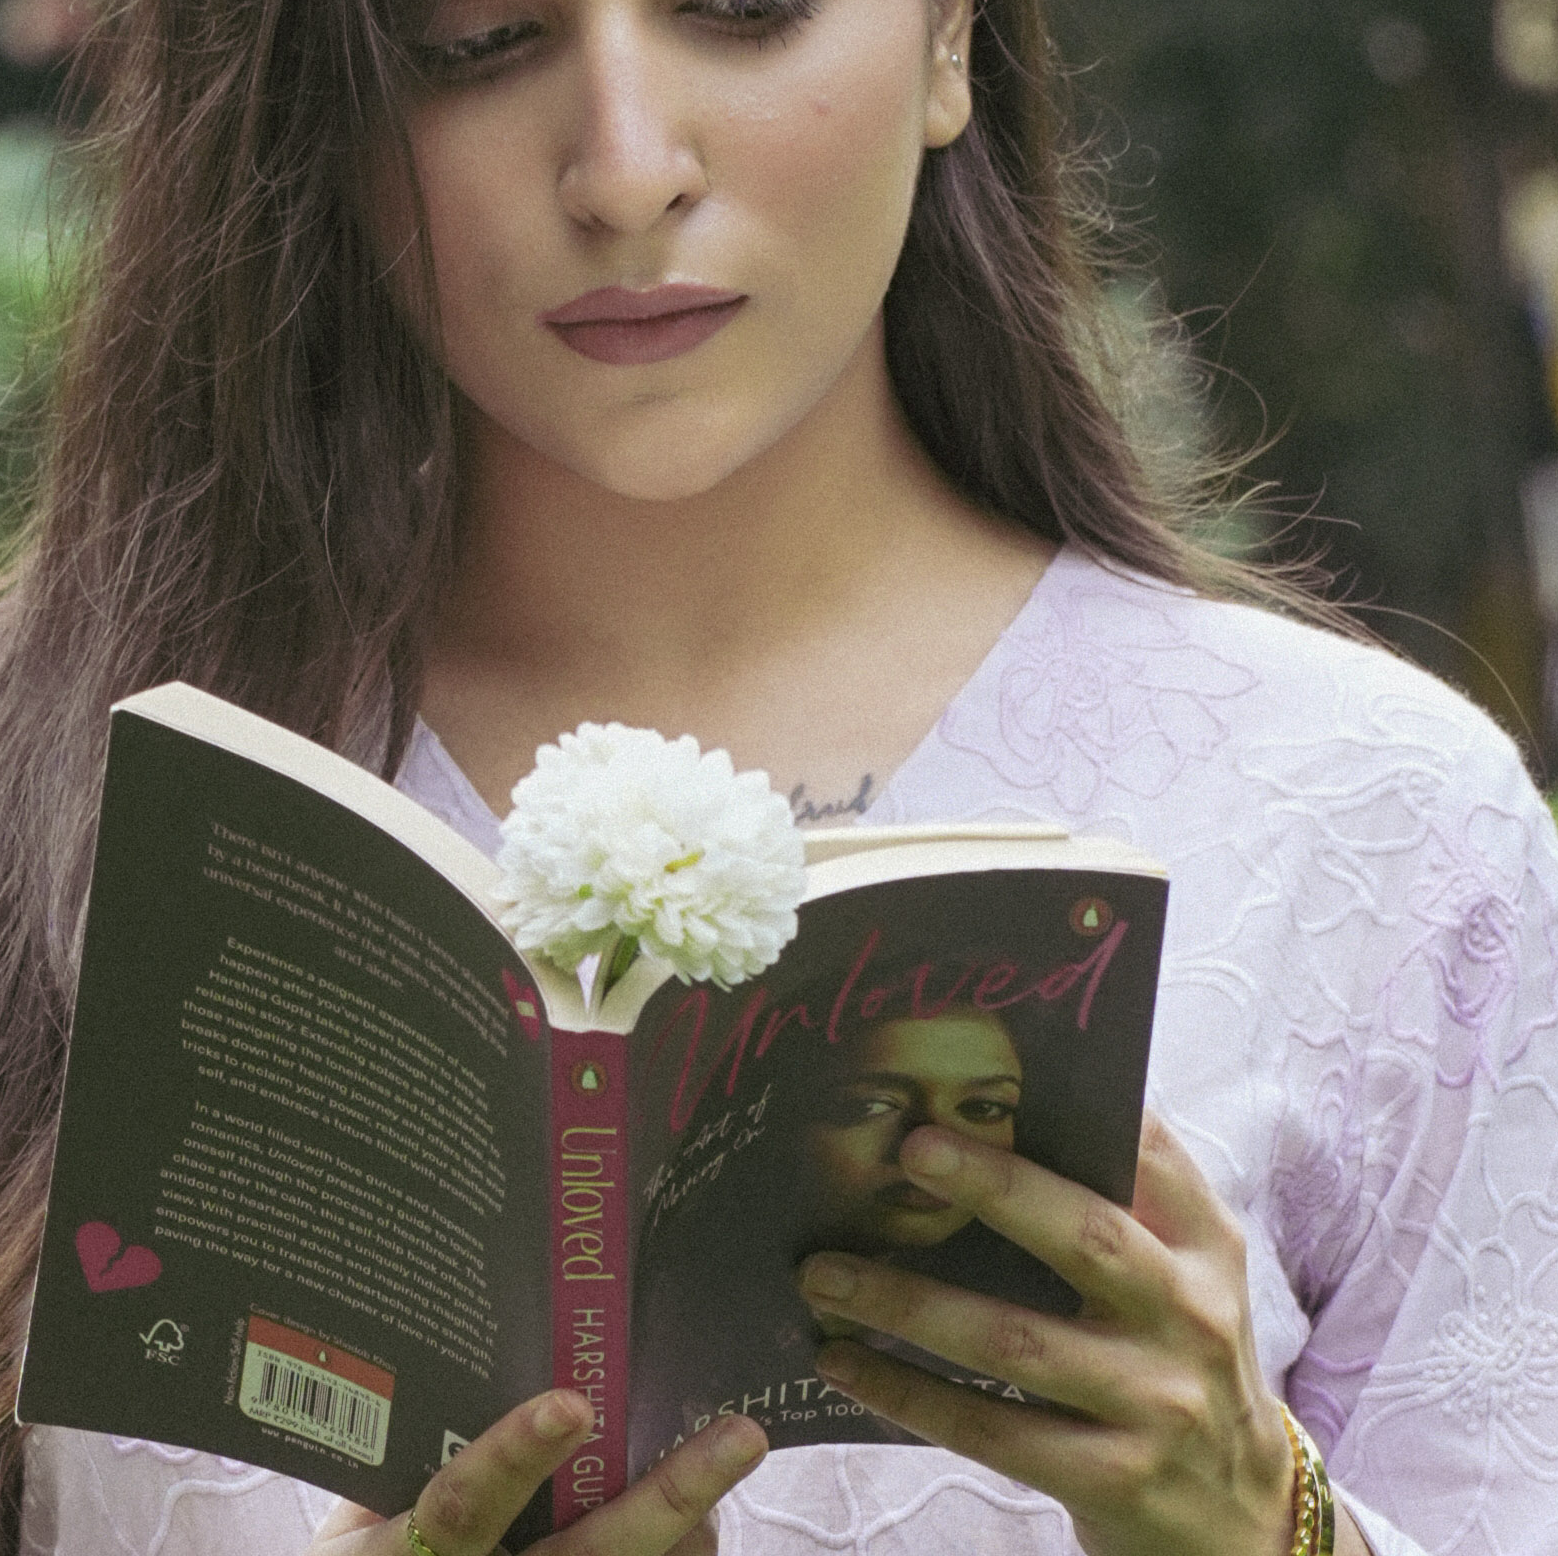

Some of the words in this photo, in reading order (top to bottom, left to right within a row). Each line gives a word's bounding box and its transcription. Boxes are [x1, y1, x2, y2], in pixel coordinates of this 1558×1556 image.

[208, 969, 268, 1001] Harshita
[270, 993, 312, 1020] Gupta
[315, 1013, 350, 1038] takes
[353, 1033, 377, 1052] you
[219, 953, 279, 986] happens
[282, 980, 314, 1000] after
[317, 996, 360, 1024] you've
[362, 1017, 395, 1043] been
[226, 935, 304, 977] Experience
[306, 972, 316, 983] a
[317, 977, 376, 1013] poignant
[180, 1018, 228, 1044] breaks
[230, 1037, 269, 1059] down
[272, 1052, 296, 1070] her
[298, 1063, 348, 1096] healing
[350, 1089, 400, 1122] journey
[183, 999, 223, 1022] those
[226, 1016, 298, 1054] navigating
[300, 1045, 323, 1063] the
[325, 1056, 392, 1098] loneliness
[195, 985, 257, 1016] relatable
[299, 1024, 366, 1067] Extending
[369, 1061, 410, 1091] solace
[182, 1038, 221, 1061] tricks
[224, 1053, 239, 1067] to
[241, 1061, 293, 1088] reclaim
[295, 1083, 326, 1102] your
[375, 1121, 420, 1152] rebuild
[229, 1077, 257, 1094] and
[259, 1087, 320, 1119] embrace
[321, 1114, 331, 1125] a
[333, 1117, 373, 1145] future
[375, 1138, 408, 1164] filled
[182, 1137, 236, 1162] oneself
[238, 1155, 293, 1184] through
[295, 1177, 318, 1195] the
[320, 1190, 374, 1221] process
[376, 1216, 391, 1229] of
[194, 1100, 209, 1115] In
[211, 1108, 221, 1119] a
[223, 1113, 264, 1134] world
[267, 1126, 301, 1150] filled
[303, 1144, 333, 1163] with
[335, 1156, 363, 1178] love
[365, 1173, 403, 1199] gurus
[267, 1147, 325, 1178] Unloved
[325, 1173, 383, 1207] presents
[385, 1202, 394, 1213] a
[159, 1168, 219, 1195] antidote
[221, 1187, 236, 1201] to
[238, 1193, 309, 1229] heartache
[311, 1224, 341, 1243] with
[343, 1238, 352, 1248] a
[354, 1243, 411, 1278] uniquely
[172, 1153, 215, 1175] chaos
[218, 1169, 251, 1186] after
[255, 1180, 278, 1197] the
[320, 1207, 345, 1226] this
[348, 1221, 404, 1256] self-help
[561, 1126, 618, 1282] Unloved
[154, 1225, 202, 1249] paving
[205, 1240, 229, 1256] the
[231, 1249, 260, 1267] way
[262, 1258, 282, 1274] for
[284, 1269, 293, 1280] a
[296, 1274, 325, 1293] new
[327, 1287, 379, 1316] chapter
[380, 1313, 395, 1325] of
[155, 1206, 230, 1237] empowers
[232, 1231, 258, 1247] you
[261, 1240, 276, 1253] to
[278, 1246, 344, 1282] transform
[346, 1275, 412, 1316] heartache
[200, 1199, 234, 1219] With
[236, 1213, 297, 1242] practical
[299, 1237, 344, 1263] advice
[346, 1258, 372, 1276] and
[374, 1271, 430, 1309] inspiring
[144, 1348, 181, 1366] FSC
[780, 1409, 818, 1423] Top
[826, 1403, 865, 1417] 100
